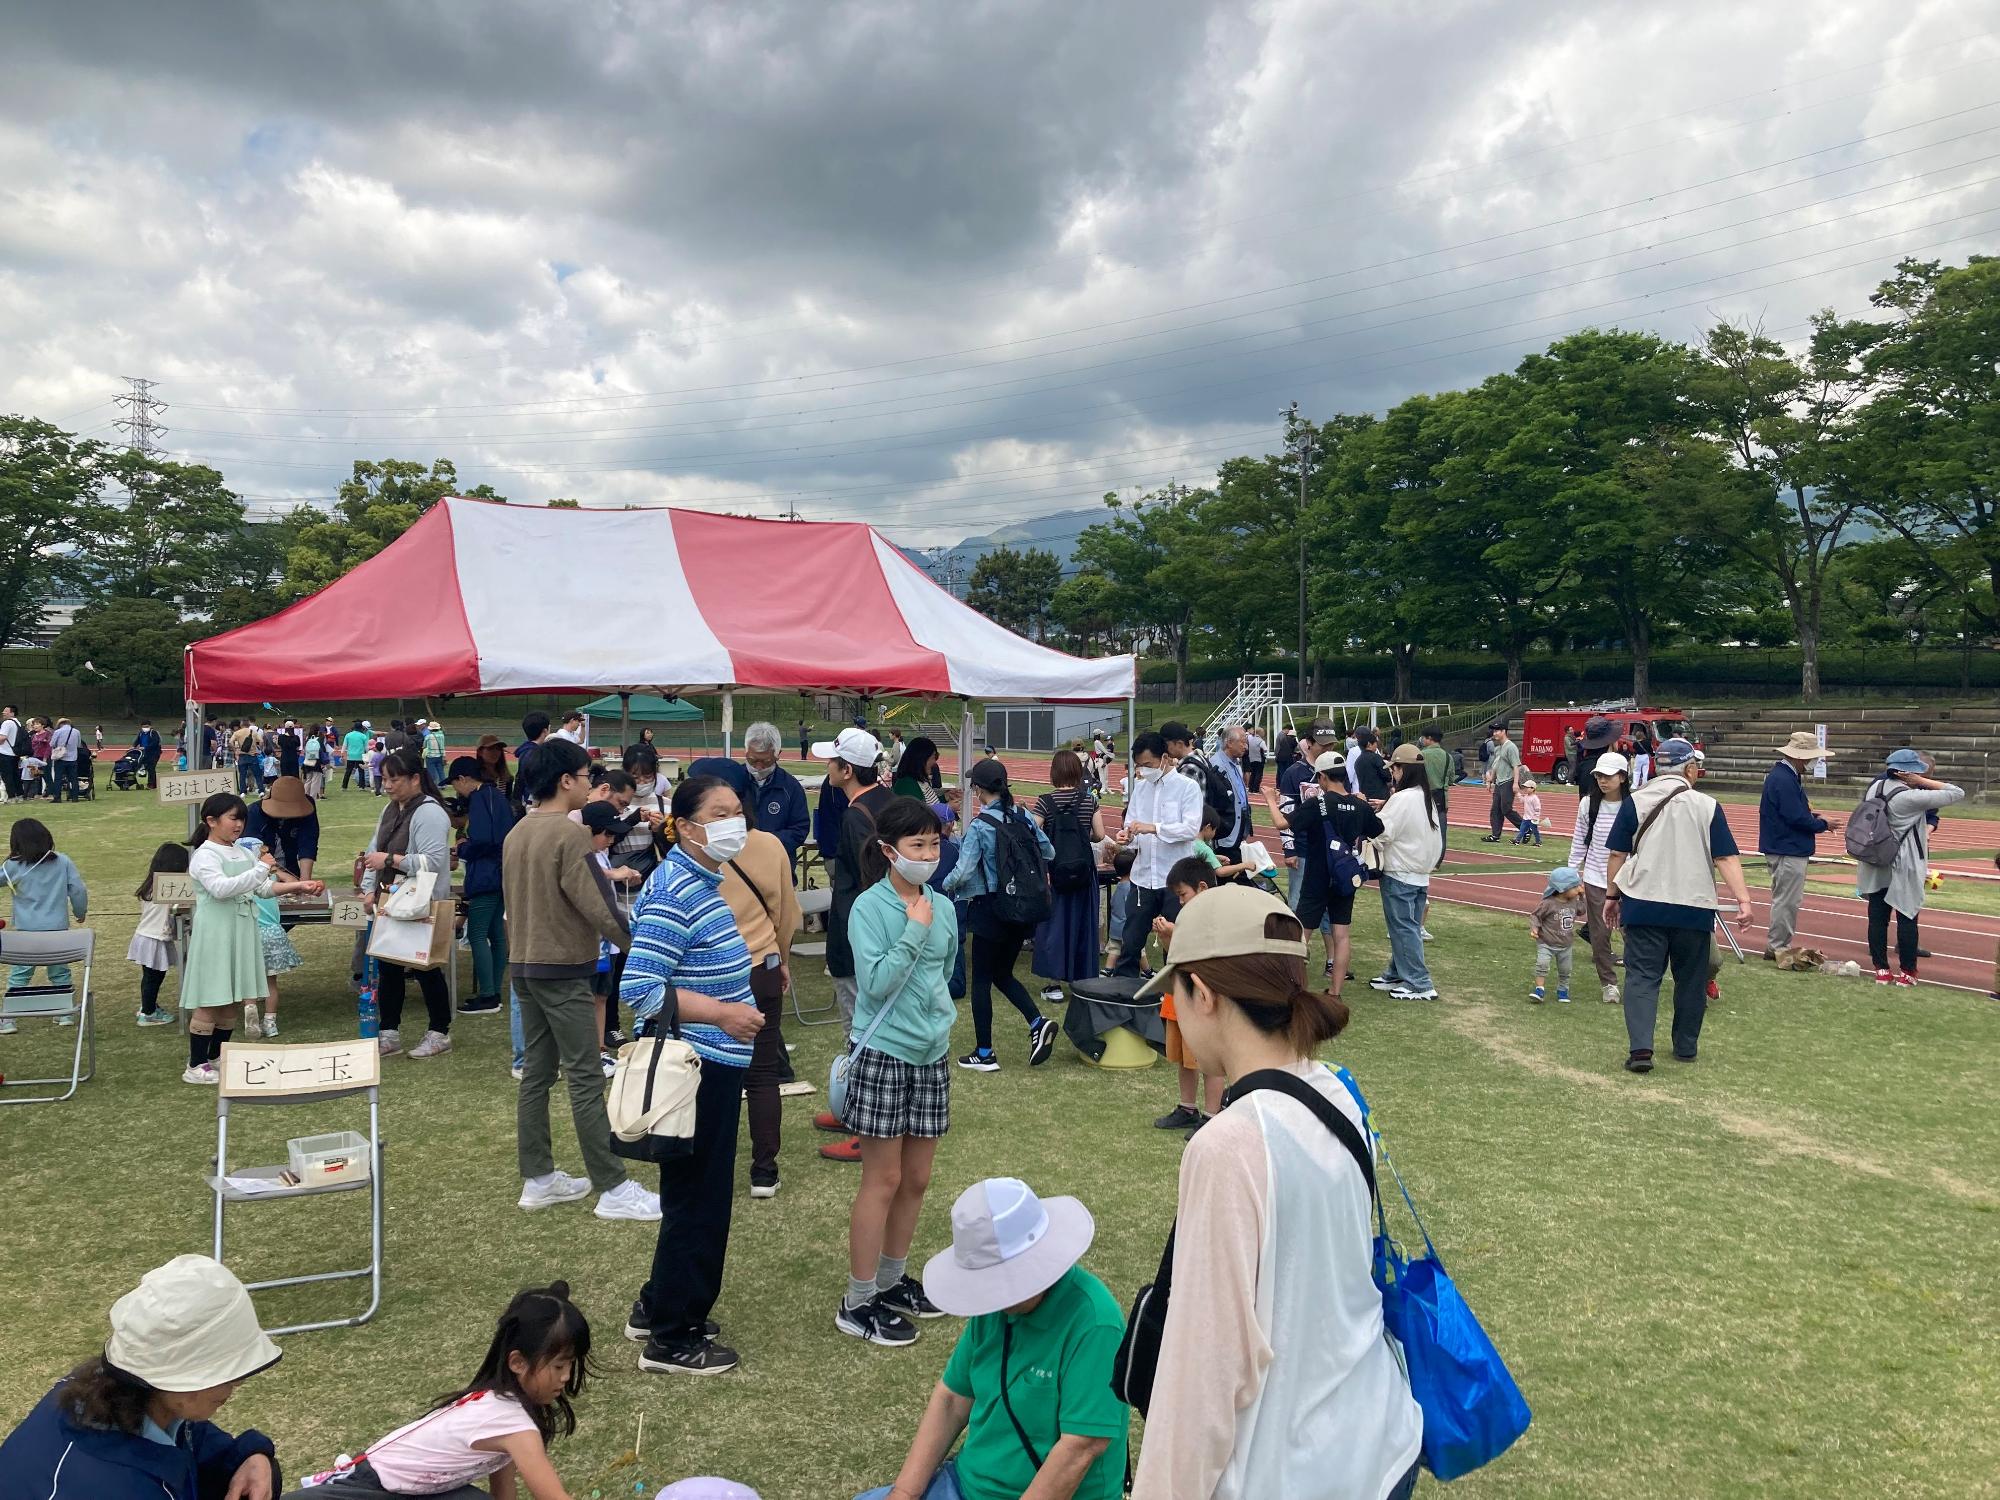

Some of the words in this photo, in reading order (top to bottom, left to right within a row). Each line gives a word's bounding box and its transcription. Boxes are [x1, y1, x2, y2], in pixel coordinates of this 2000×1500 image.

[1530, 745, 1553, 753] HADANO
[165, 776, 232, 797] おはじき
[340, 904, 367, 920] お
[244, 1053, 353, 1085] ビー玉
